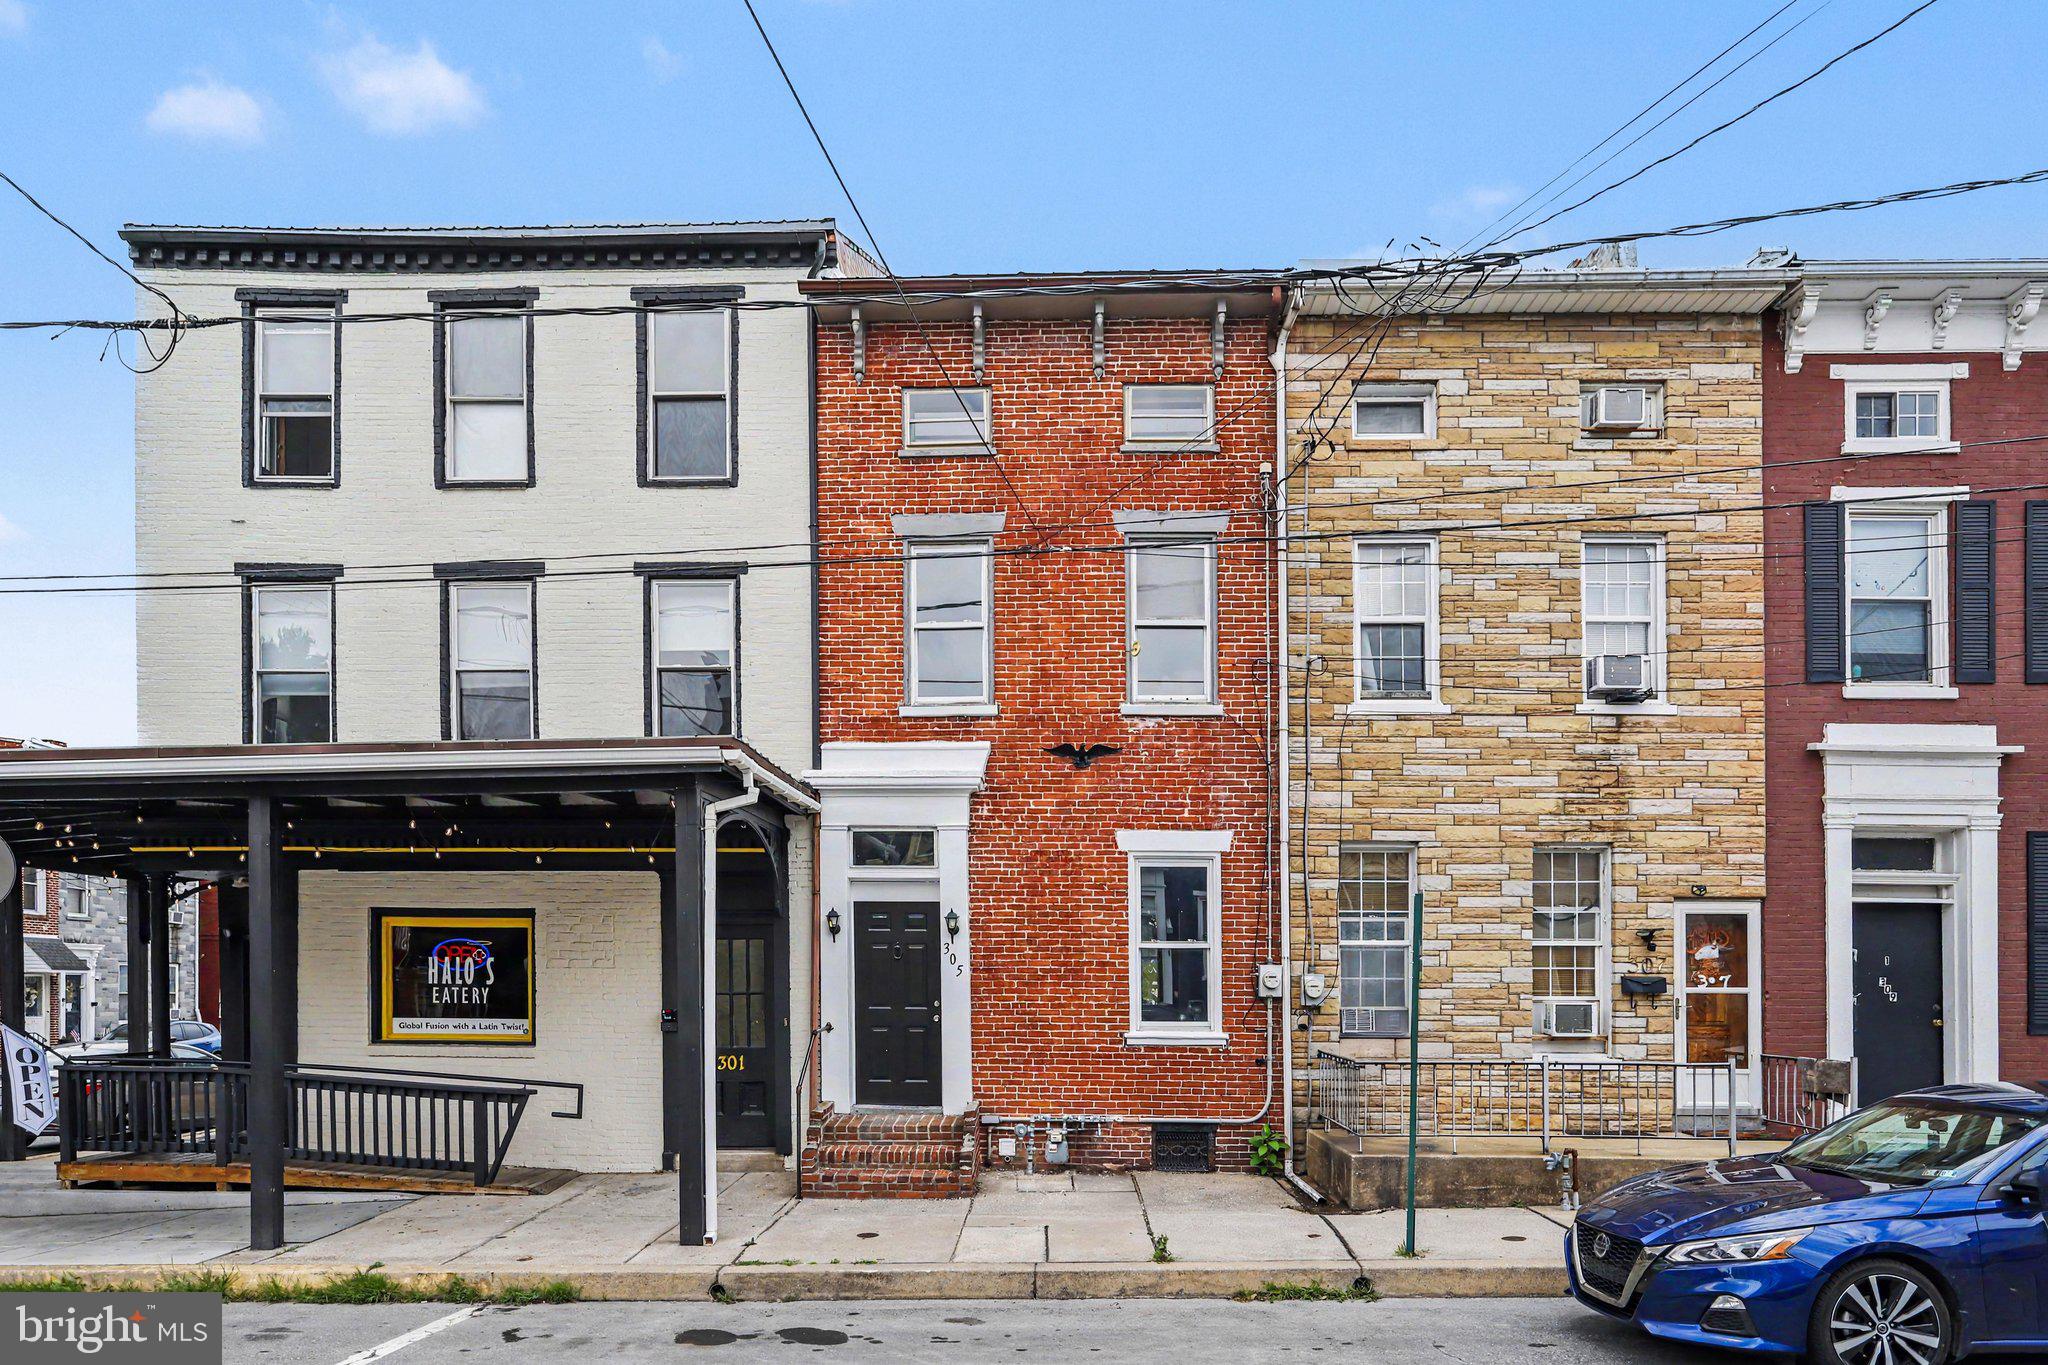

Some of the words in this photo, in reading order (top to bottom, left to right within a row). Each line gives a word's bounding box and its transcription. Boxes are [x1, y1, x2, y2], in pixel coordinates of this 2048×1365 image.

[944, 943, 963, 977] 305
[433, 987, 489, 1004] EATERY
[399, 1022, 423, 1030] Global
[425, 1022, 450, 1030] Fusion
[453, 1022, 469, 1030] with
[479, 1022, 498, 1031] Latin
[717, 1055, 745, 1071] 301
[15, 1047, 46, 1122] OPEN
